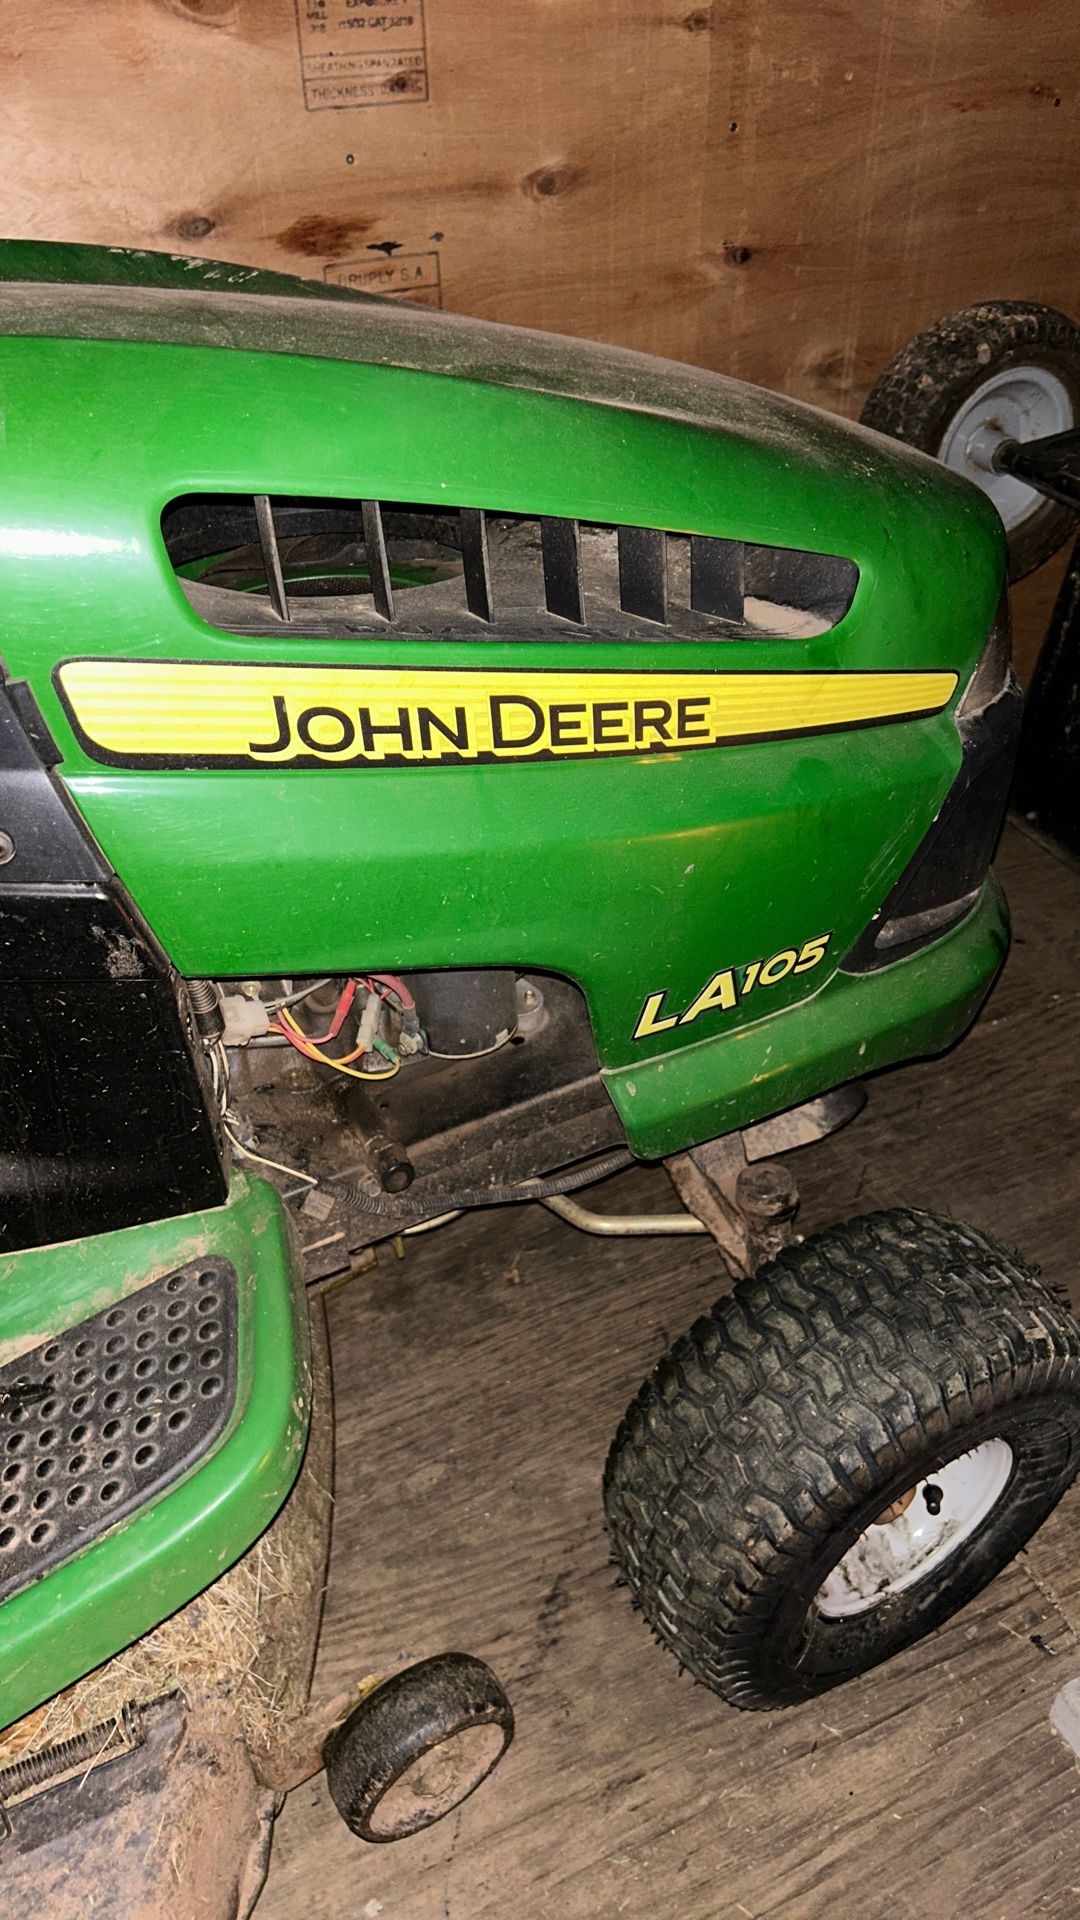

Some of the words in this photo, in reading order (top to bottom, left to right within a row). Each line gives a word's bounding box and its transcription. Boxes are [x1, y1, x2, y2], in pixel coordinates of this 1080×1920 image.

[311, 84, 374, 100] THICKNESS
[248, 695, 469, 754] JOHN
[488, 694, 711, 749] DEERE
[631, 931, 833, 1040] LA105
